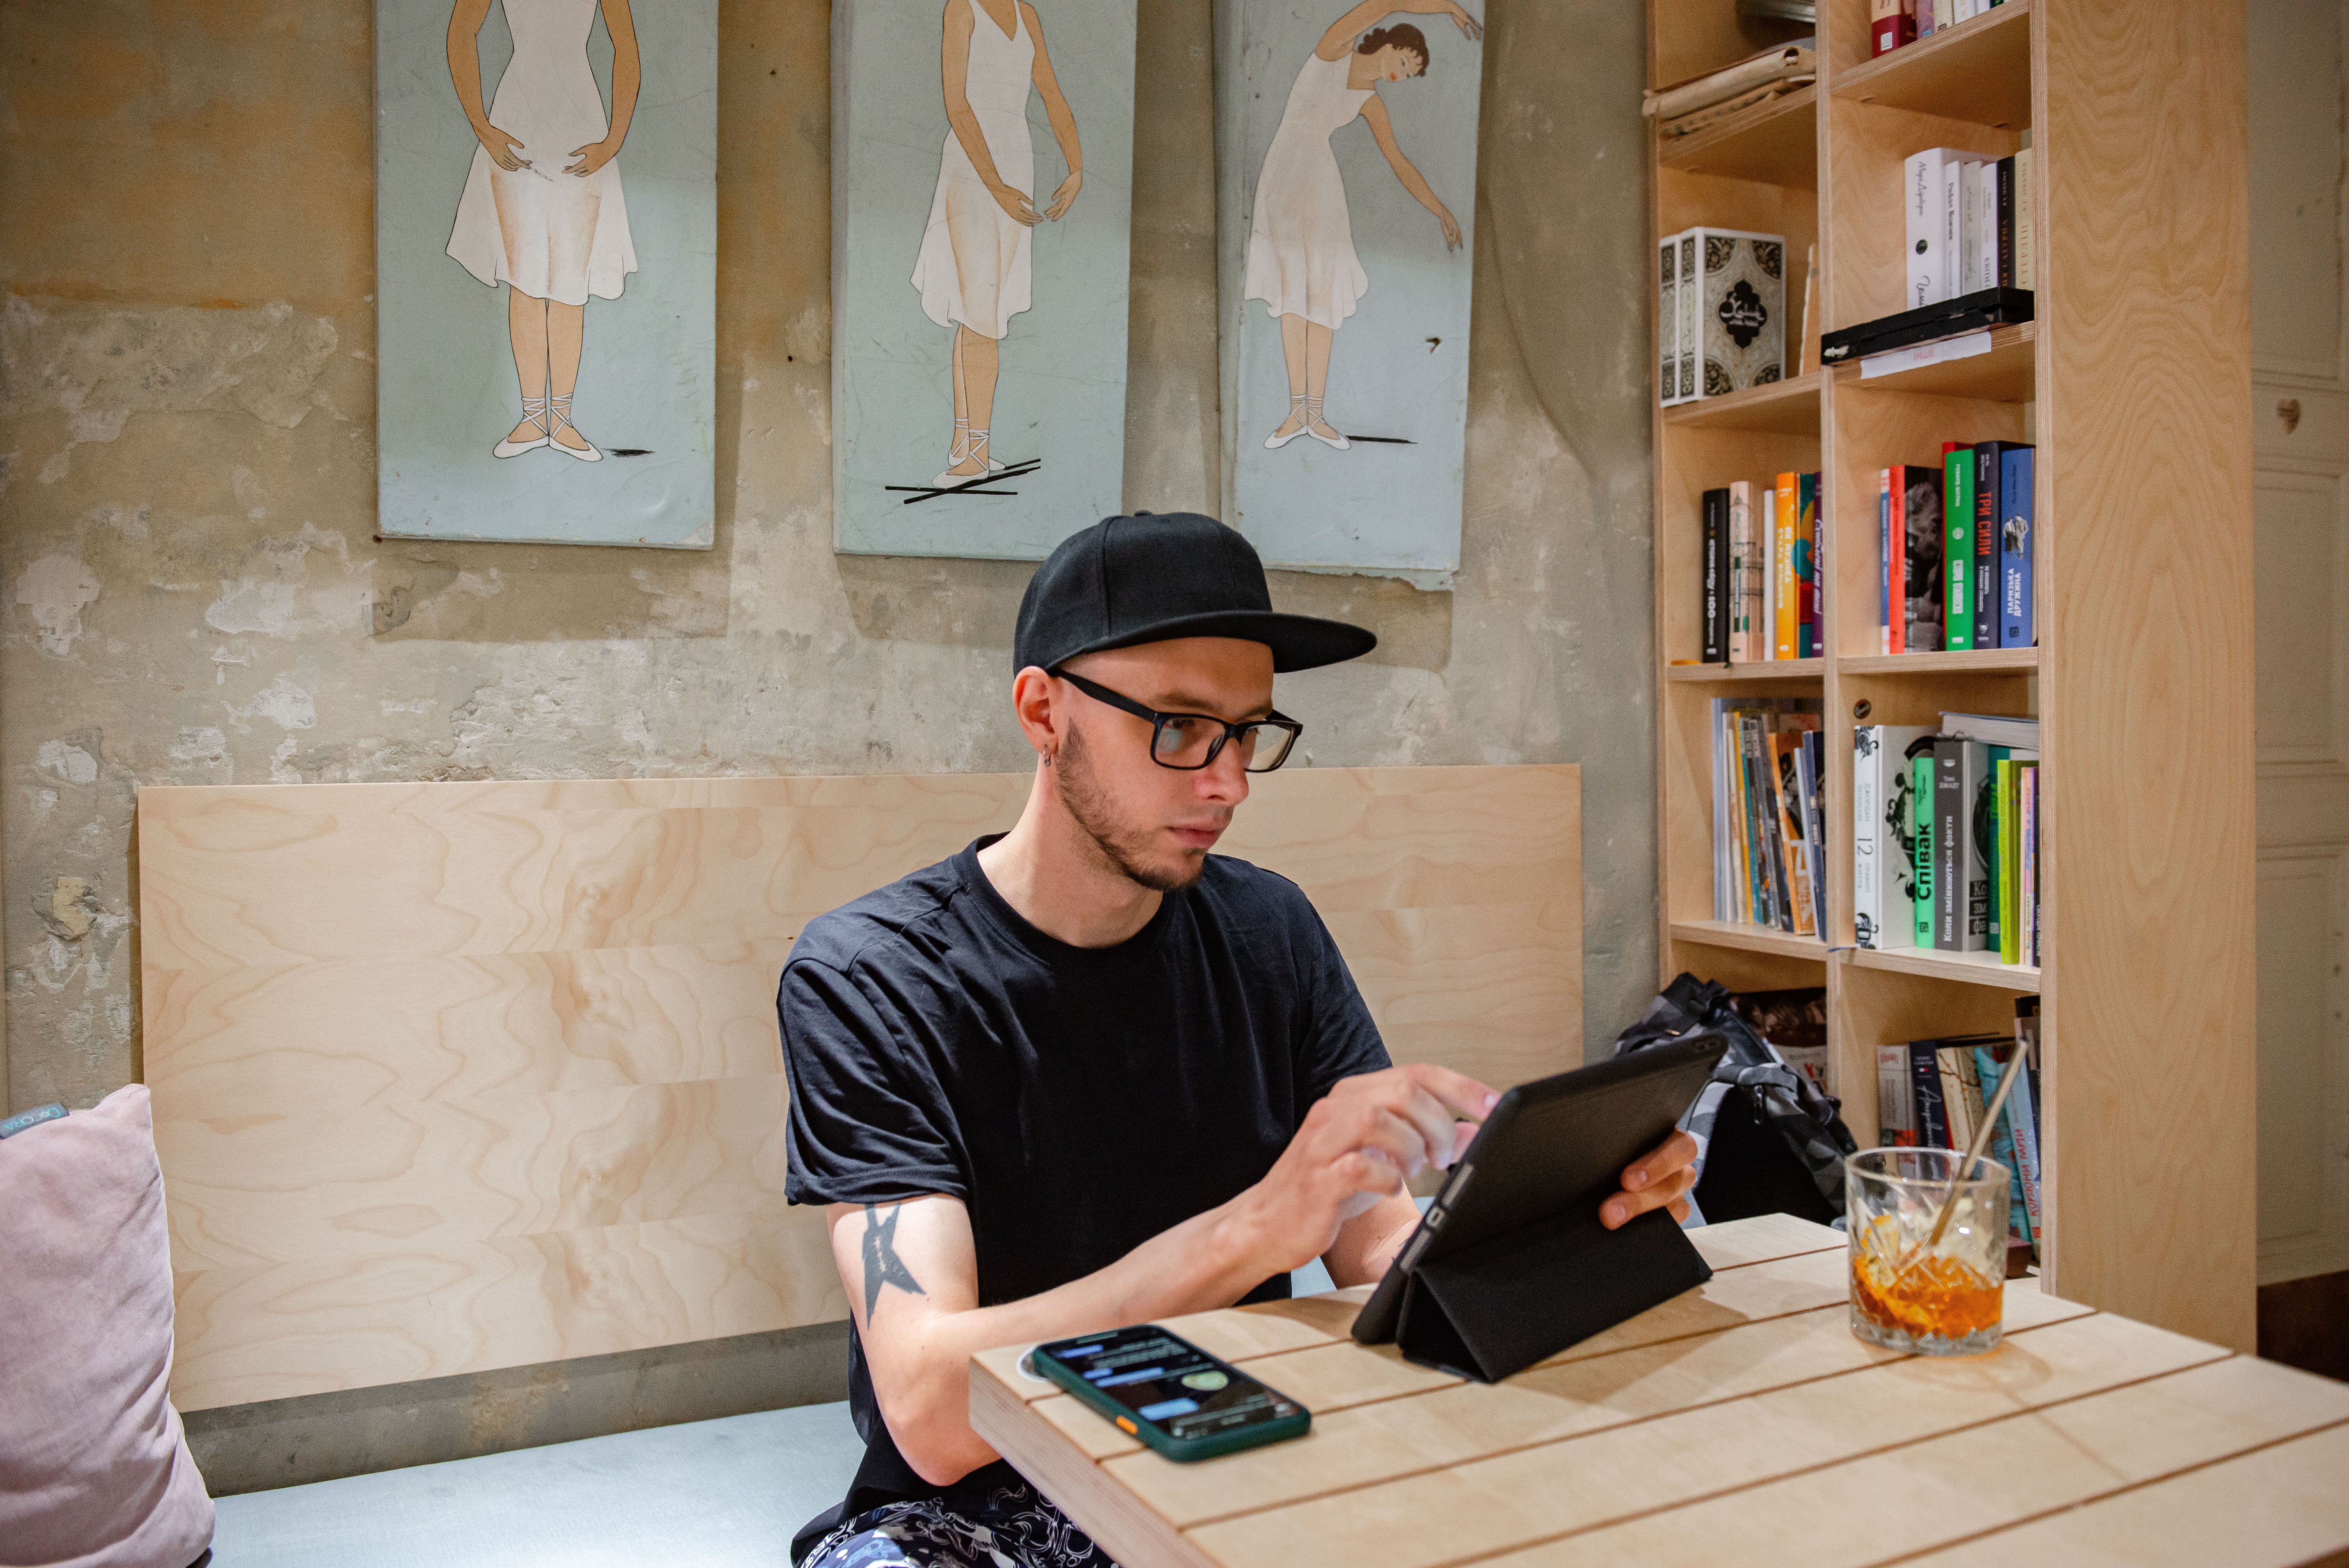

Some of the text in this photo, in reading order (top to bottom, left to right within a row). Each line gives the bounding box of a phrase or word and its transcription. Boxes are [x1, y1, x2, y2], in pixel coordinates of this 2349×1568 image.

[1978, 491, 1992, 555] ТРИ СИЛИ
[1857, 837, 1873, 856] 12
[1944, 815, 1954, 847] факти
[1918, 823, 1931, 900] Співак
